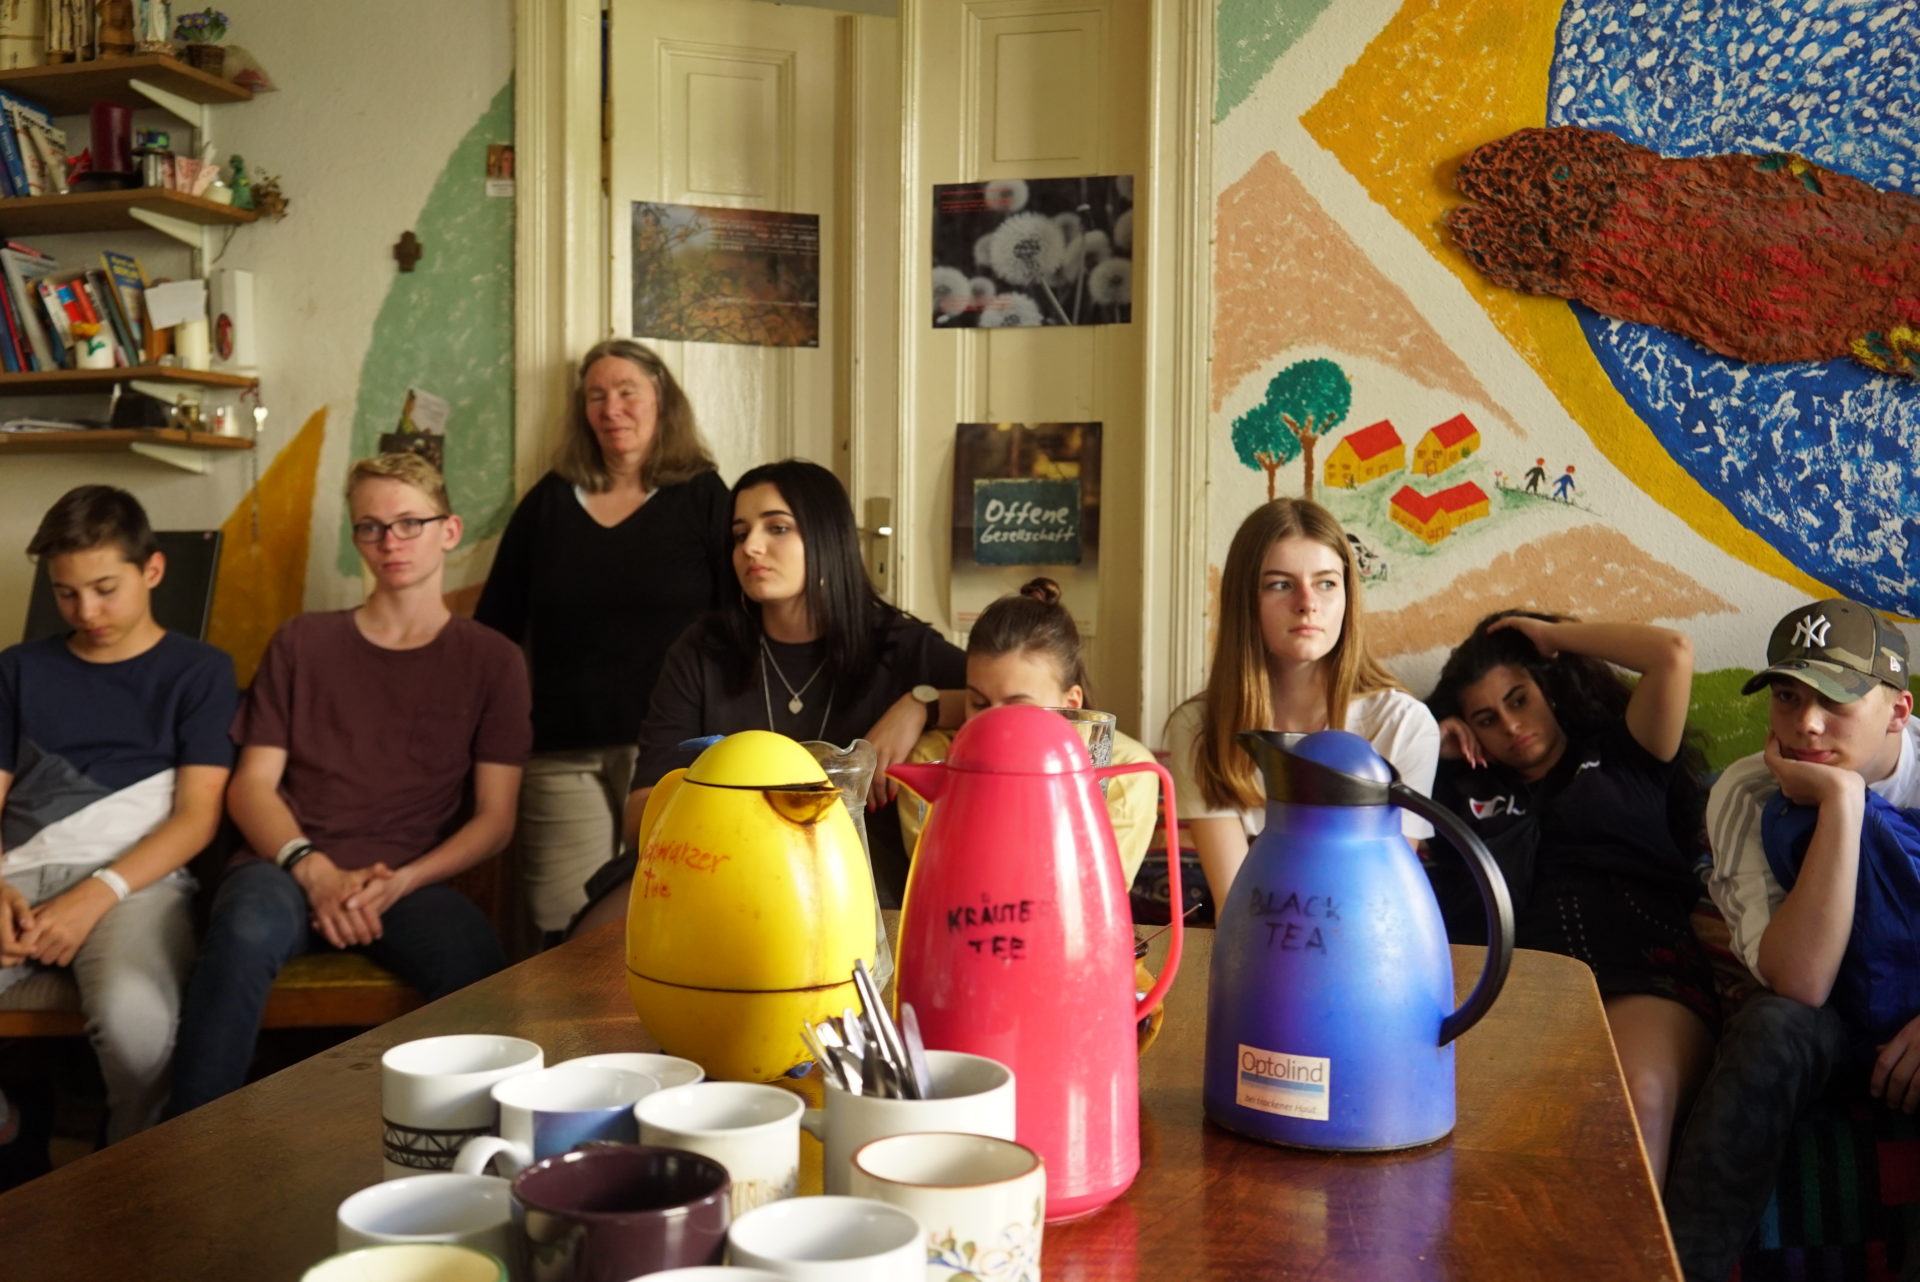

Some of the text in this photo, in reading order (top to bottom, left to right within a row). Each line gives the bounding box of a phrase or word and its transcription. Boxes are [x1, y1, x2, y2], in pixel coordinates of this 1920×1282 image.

[985, 499, 1069, 525] Offene
[1790, 614, 1831, 648] NY
[1249, 886, 1341, 920] BLACK
[967, 936, 1026, 959] TEE
[1265, 921, 1327, 955] TEA
[1242, 1051, 1323, 1082] Optolind
